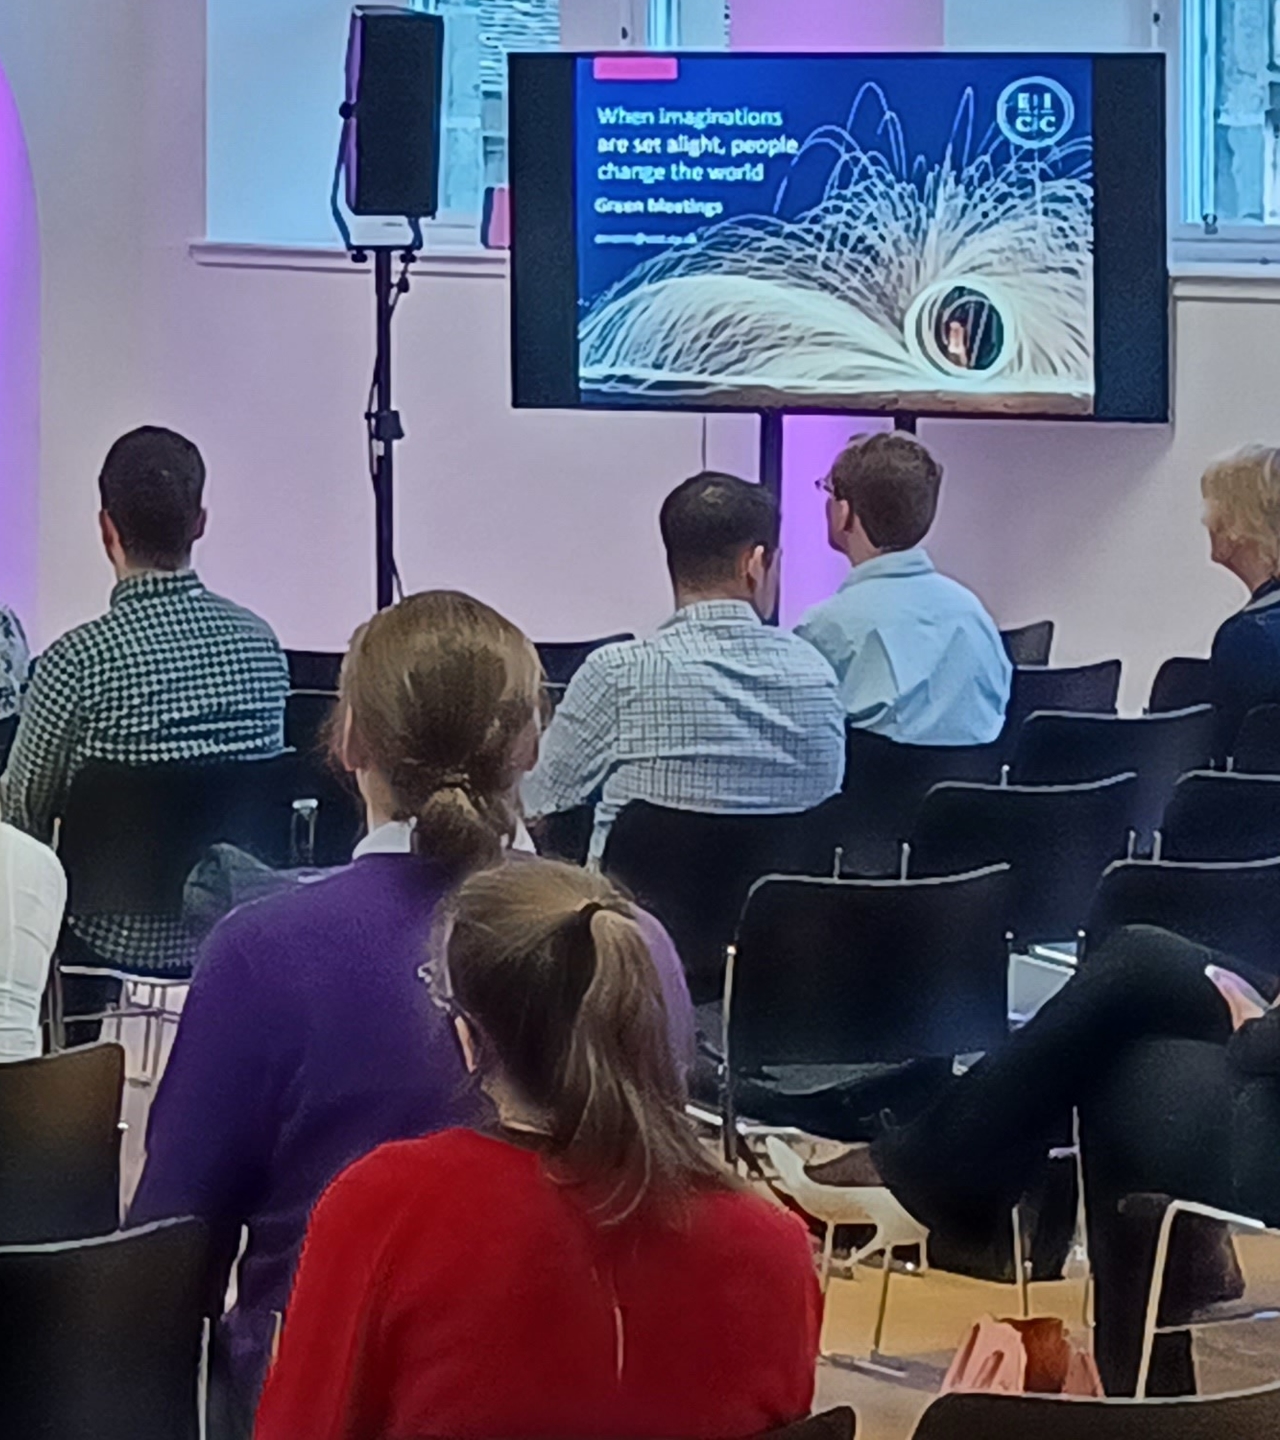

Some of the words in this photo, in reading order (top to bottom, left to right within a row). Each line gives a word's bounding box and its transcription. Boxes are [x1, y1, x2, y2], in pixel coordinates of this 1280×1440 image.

[597, 105, 654, 125] When
[658, 107, 783, 130] imaginations
[597, 137, 629, 154] are
[633, 136, 661, 154] set
[666, 134, 725, 158] alight,
[730, 135, 799, 158] people
[597, 162, 665, 184] change
[670, 160, 704, 181] the
[707, 163, 764, 181] world
